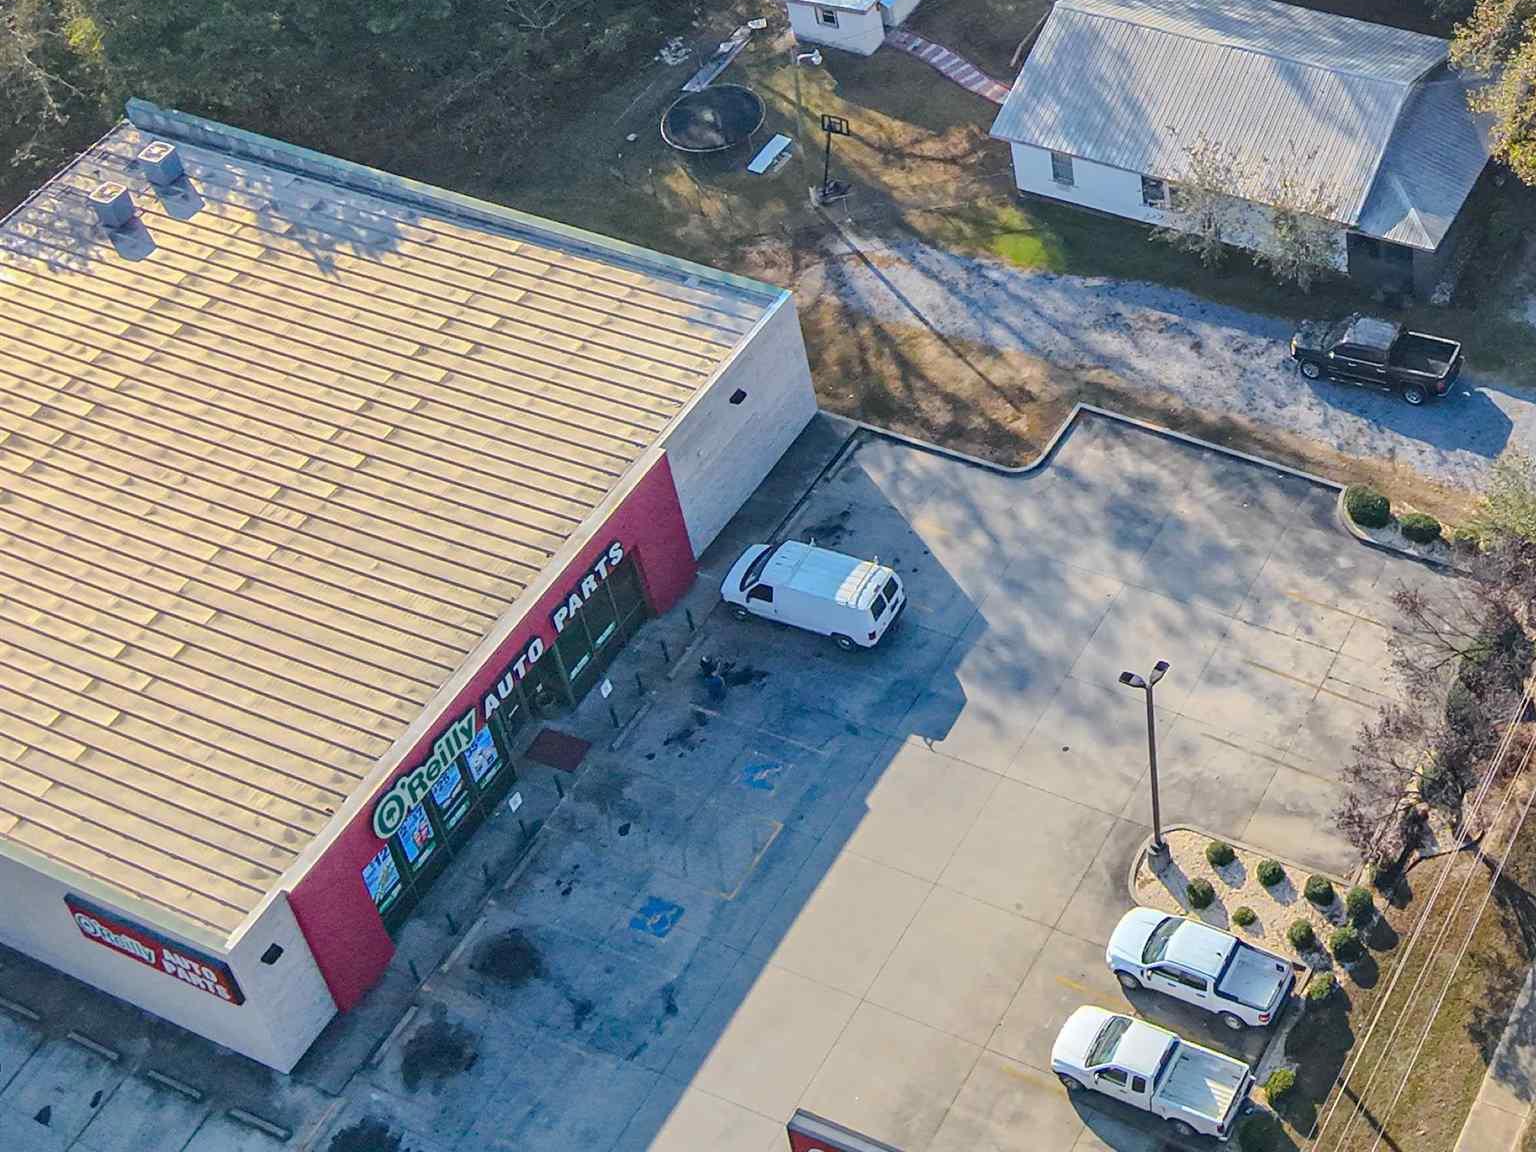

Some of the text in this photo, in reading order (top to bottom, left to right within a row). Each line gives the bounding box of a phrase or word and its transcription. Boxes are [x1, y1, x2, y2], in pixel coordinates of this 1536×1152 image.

[374, 541, 624, 840] O'Reilly AUTO PARTS
[162, 949, 218, 984] AUTO
[162, 961, 232, 1000] PARTS
